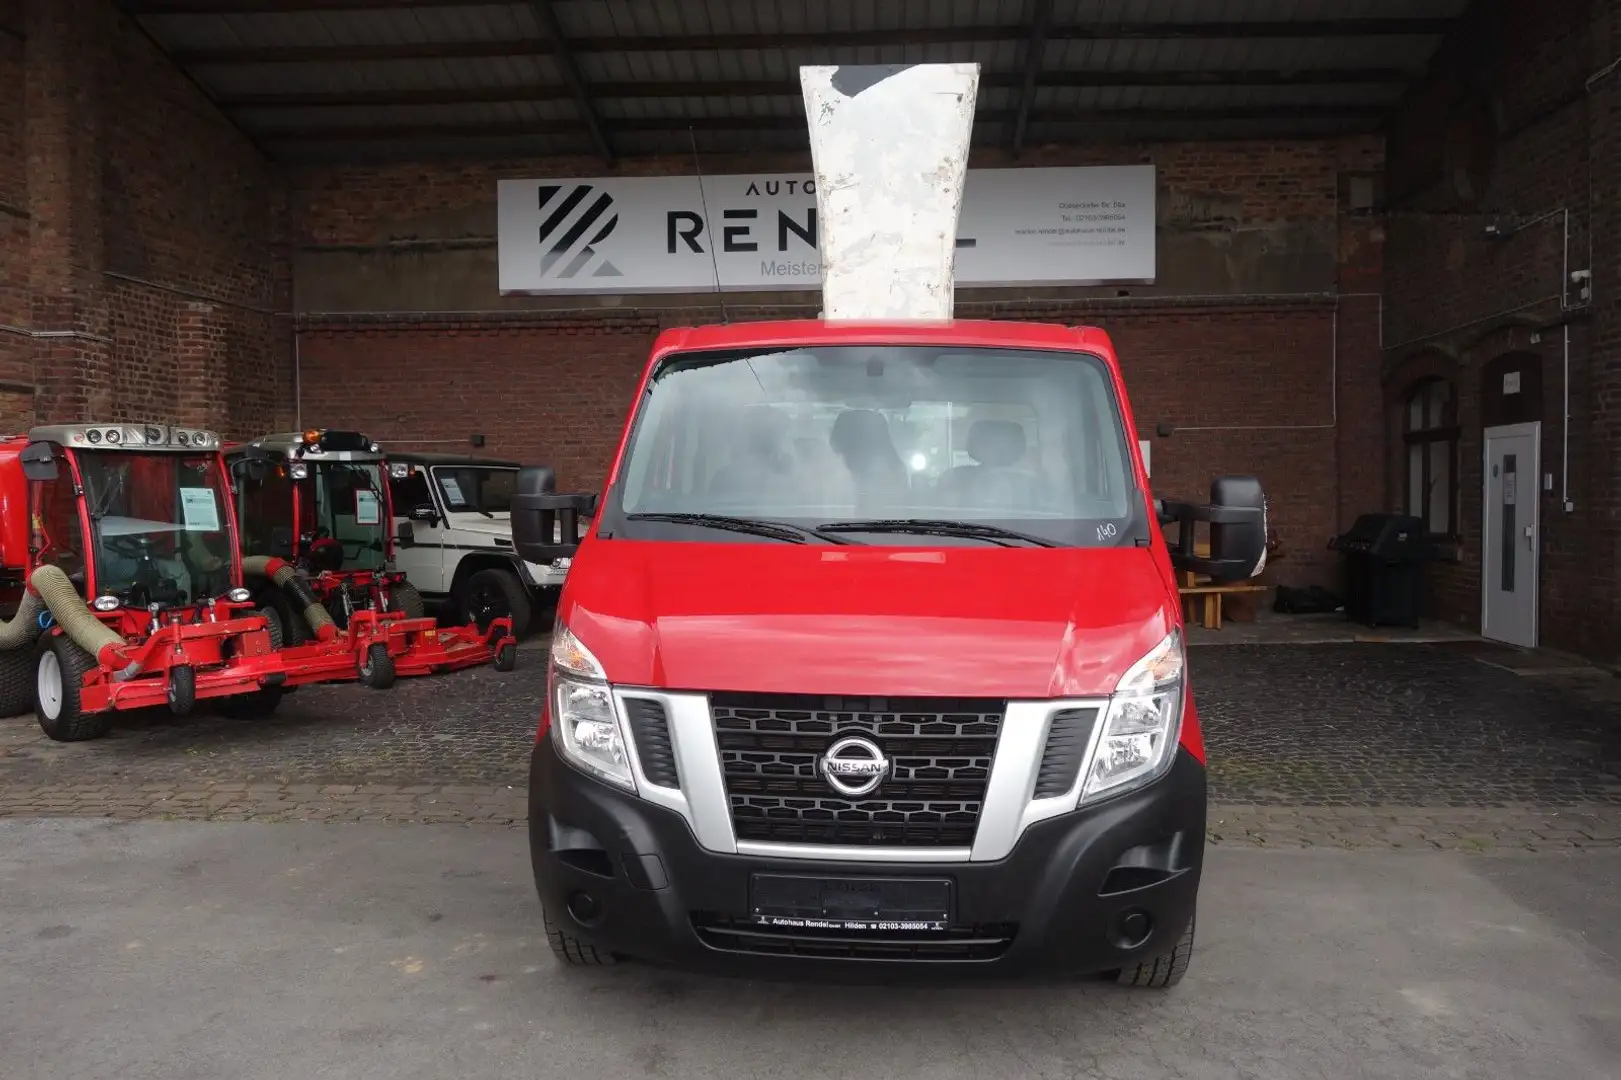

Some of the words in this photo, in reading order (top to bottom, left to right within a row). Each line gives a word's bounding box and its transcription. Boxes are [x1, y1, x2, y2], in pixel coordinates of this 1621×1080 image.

[827, 762, 880, 773] NISSAN
[772, 918, 804, 927] Autohaus
[844, 921, 867, 930] Hilden
